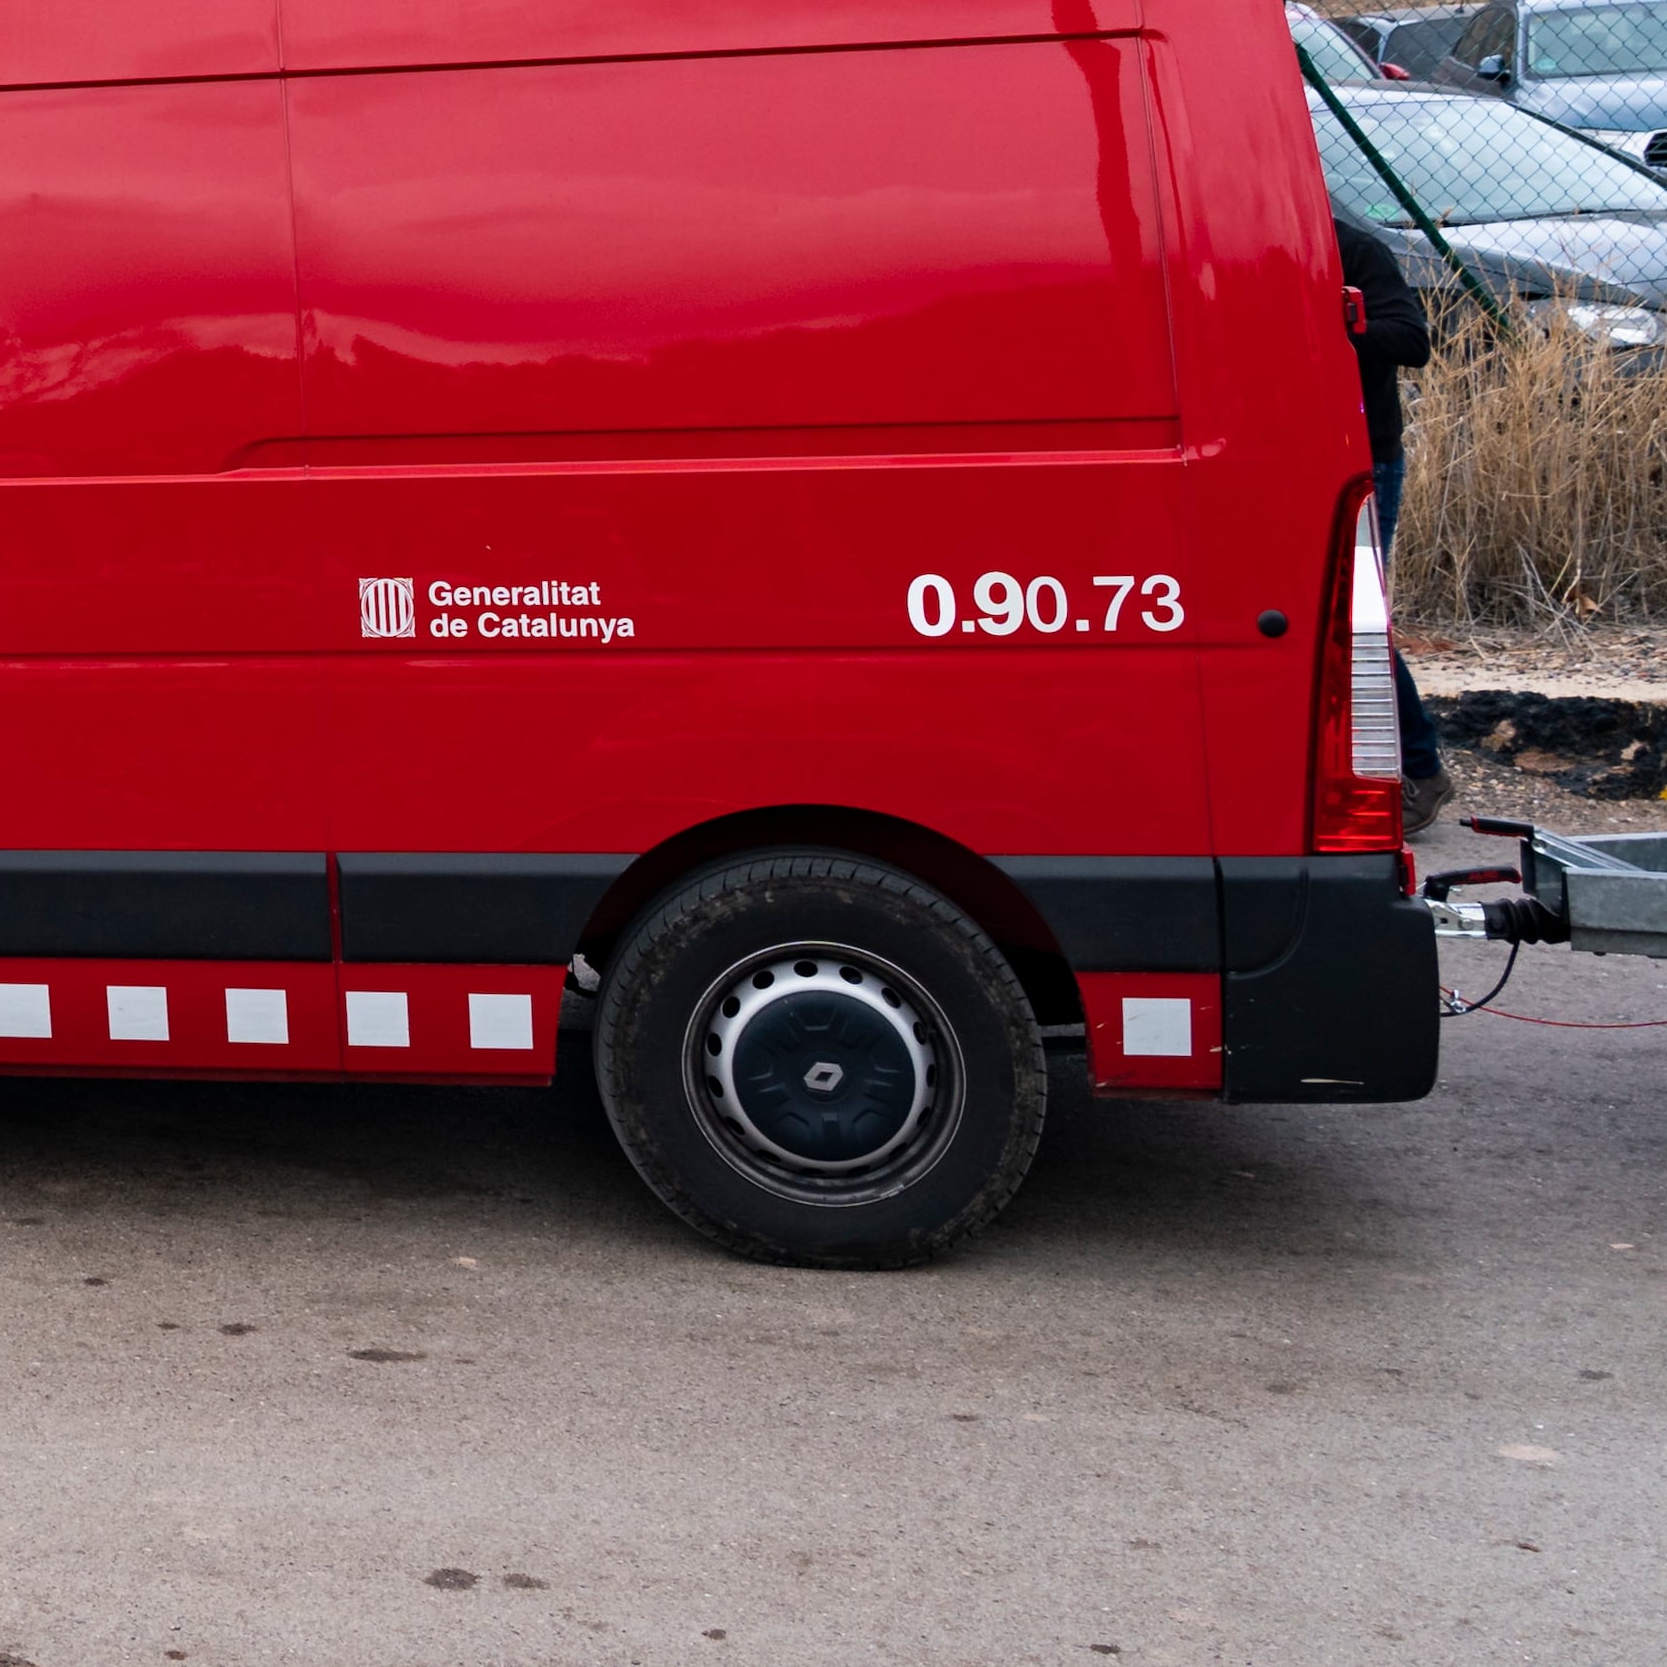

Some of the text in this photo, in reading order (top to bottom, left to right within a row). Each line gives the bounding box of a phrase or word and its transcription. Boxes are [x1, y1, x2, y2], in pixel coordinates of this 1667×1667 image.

[428, 581, 601, 606] Generalitat
[907, 571, 1185, 637] 0.90.73
[429, 612, 635, 644] de Catalunya
